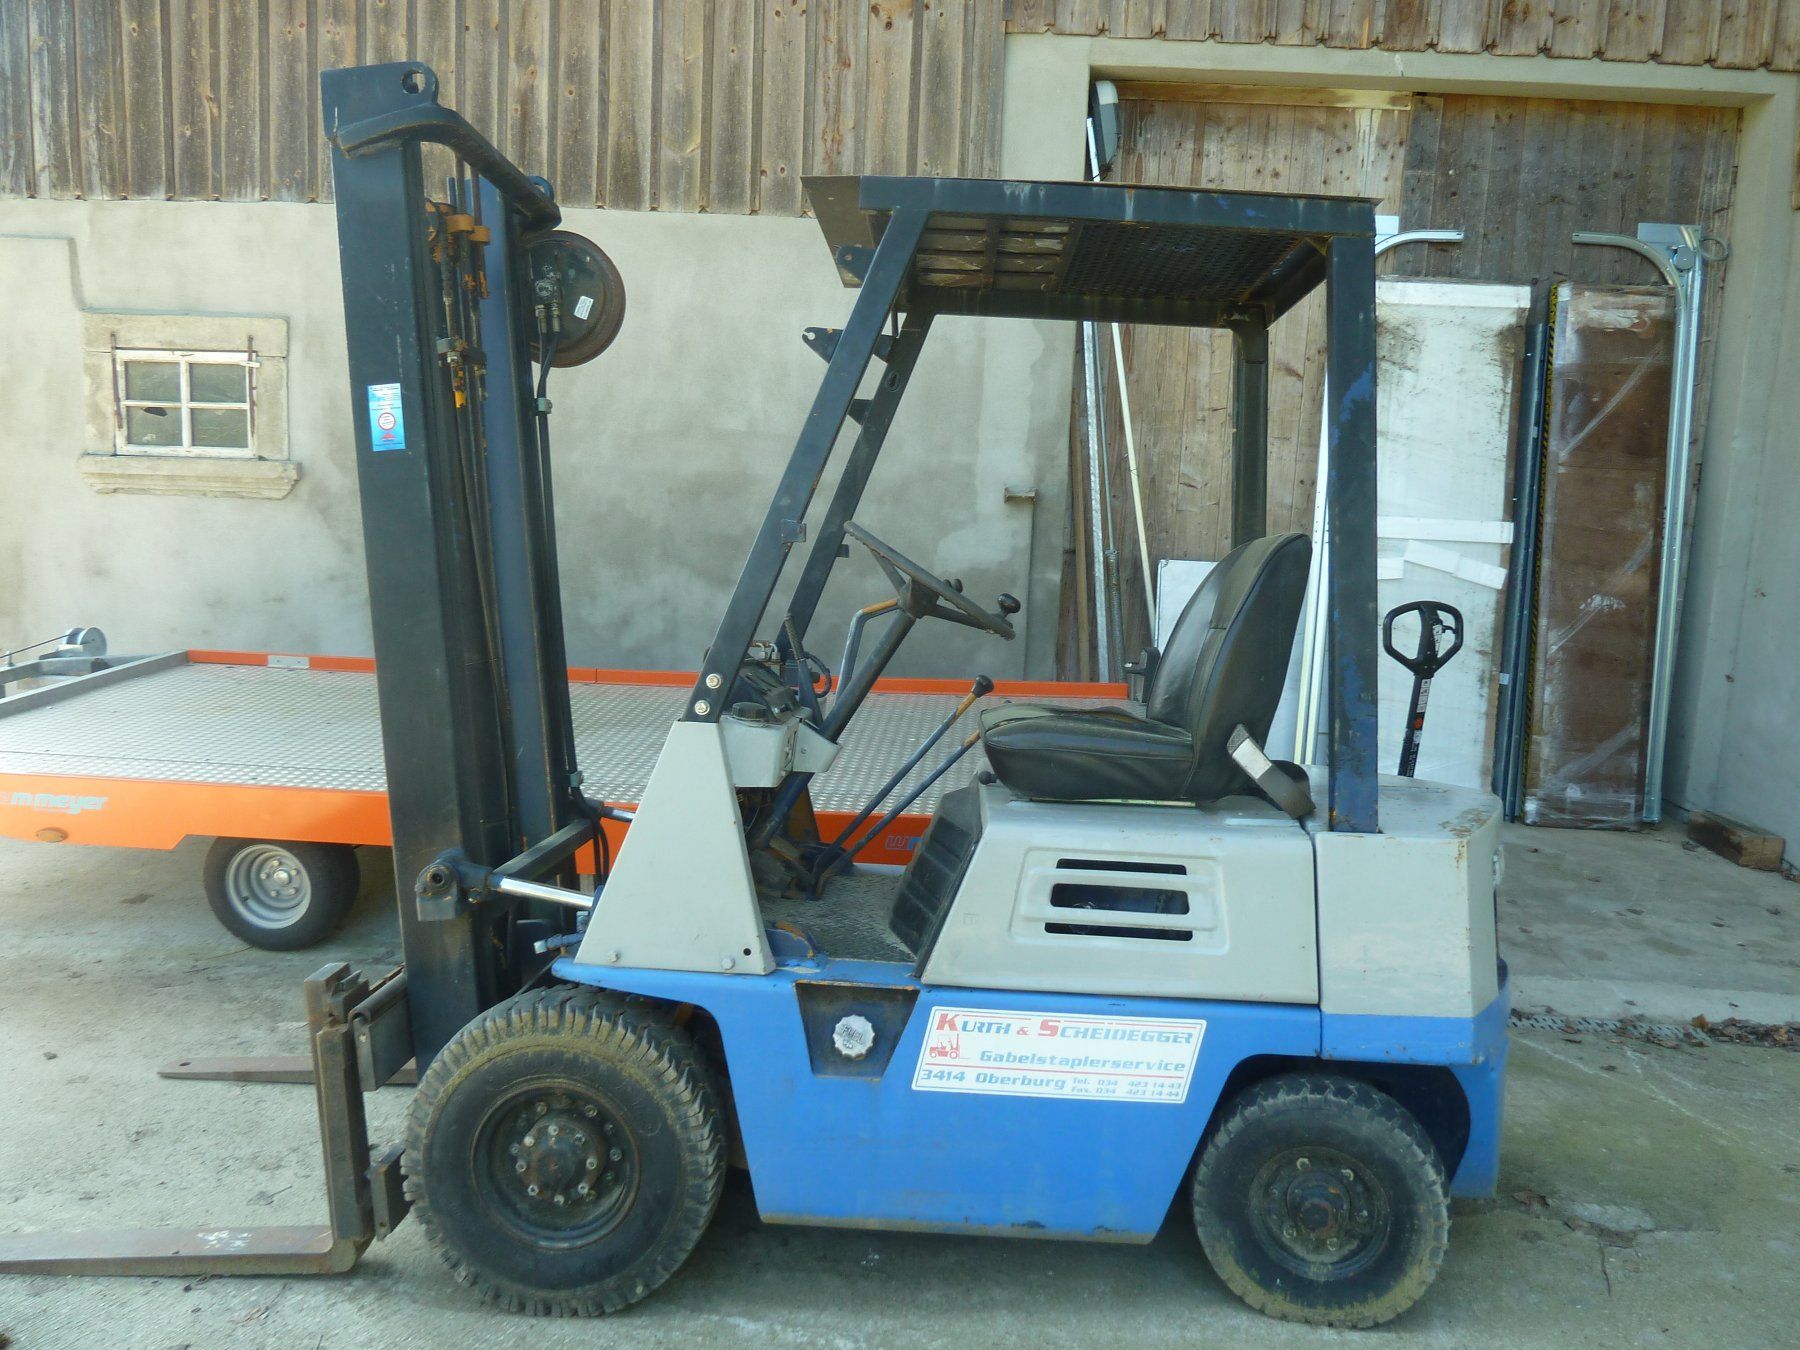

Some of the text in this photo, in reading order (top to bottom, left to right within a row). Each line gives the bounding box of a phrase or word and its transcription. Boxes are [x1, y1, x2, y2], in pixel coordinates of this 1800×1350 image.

[936, 1012, 1011, 1035] KURTH
[1016, 1025, 1030, 1036] &
[979, 1050, 1186, 1073] Gabelstaplerservice
[920, 1068, 1066, 1091] 3414 Oberburg
